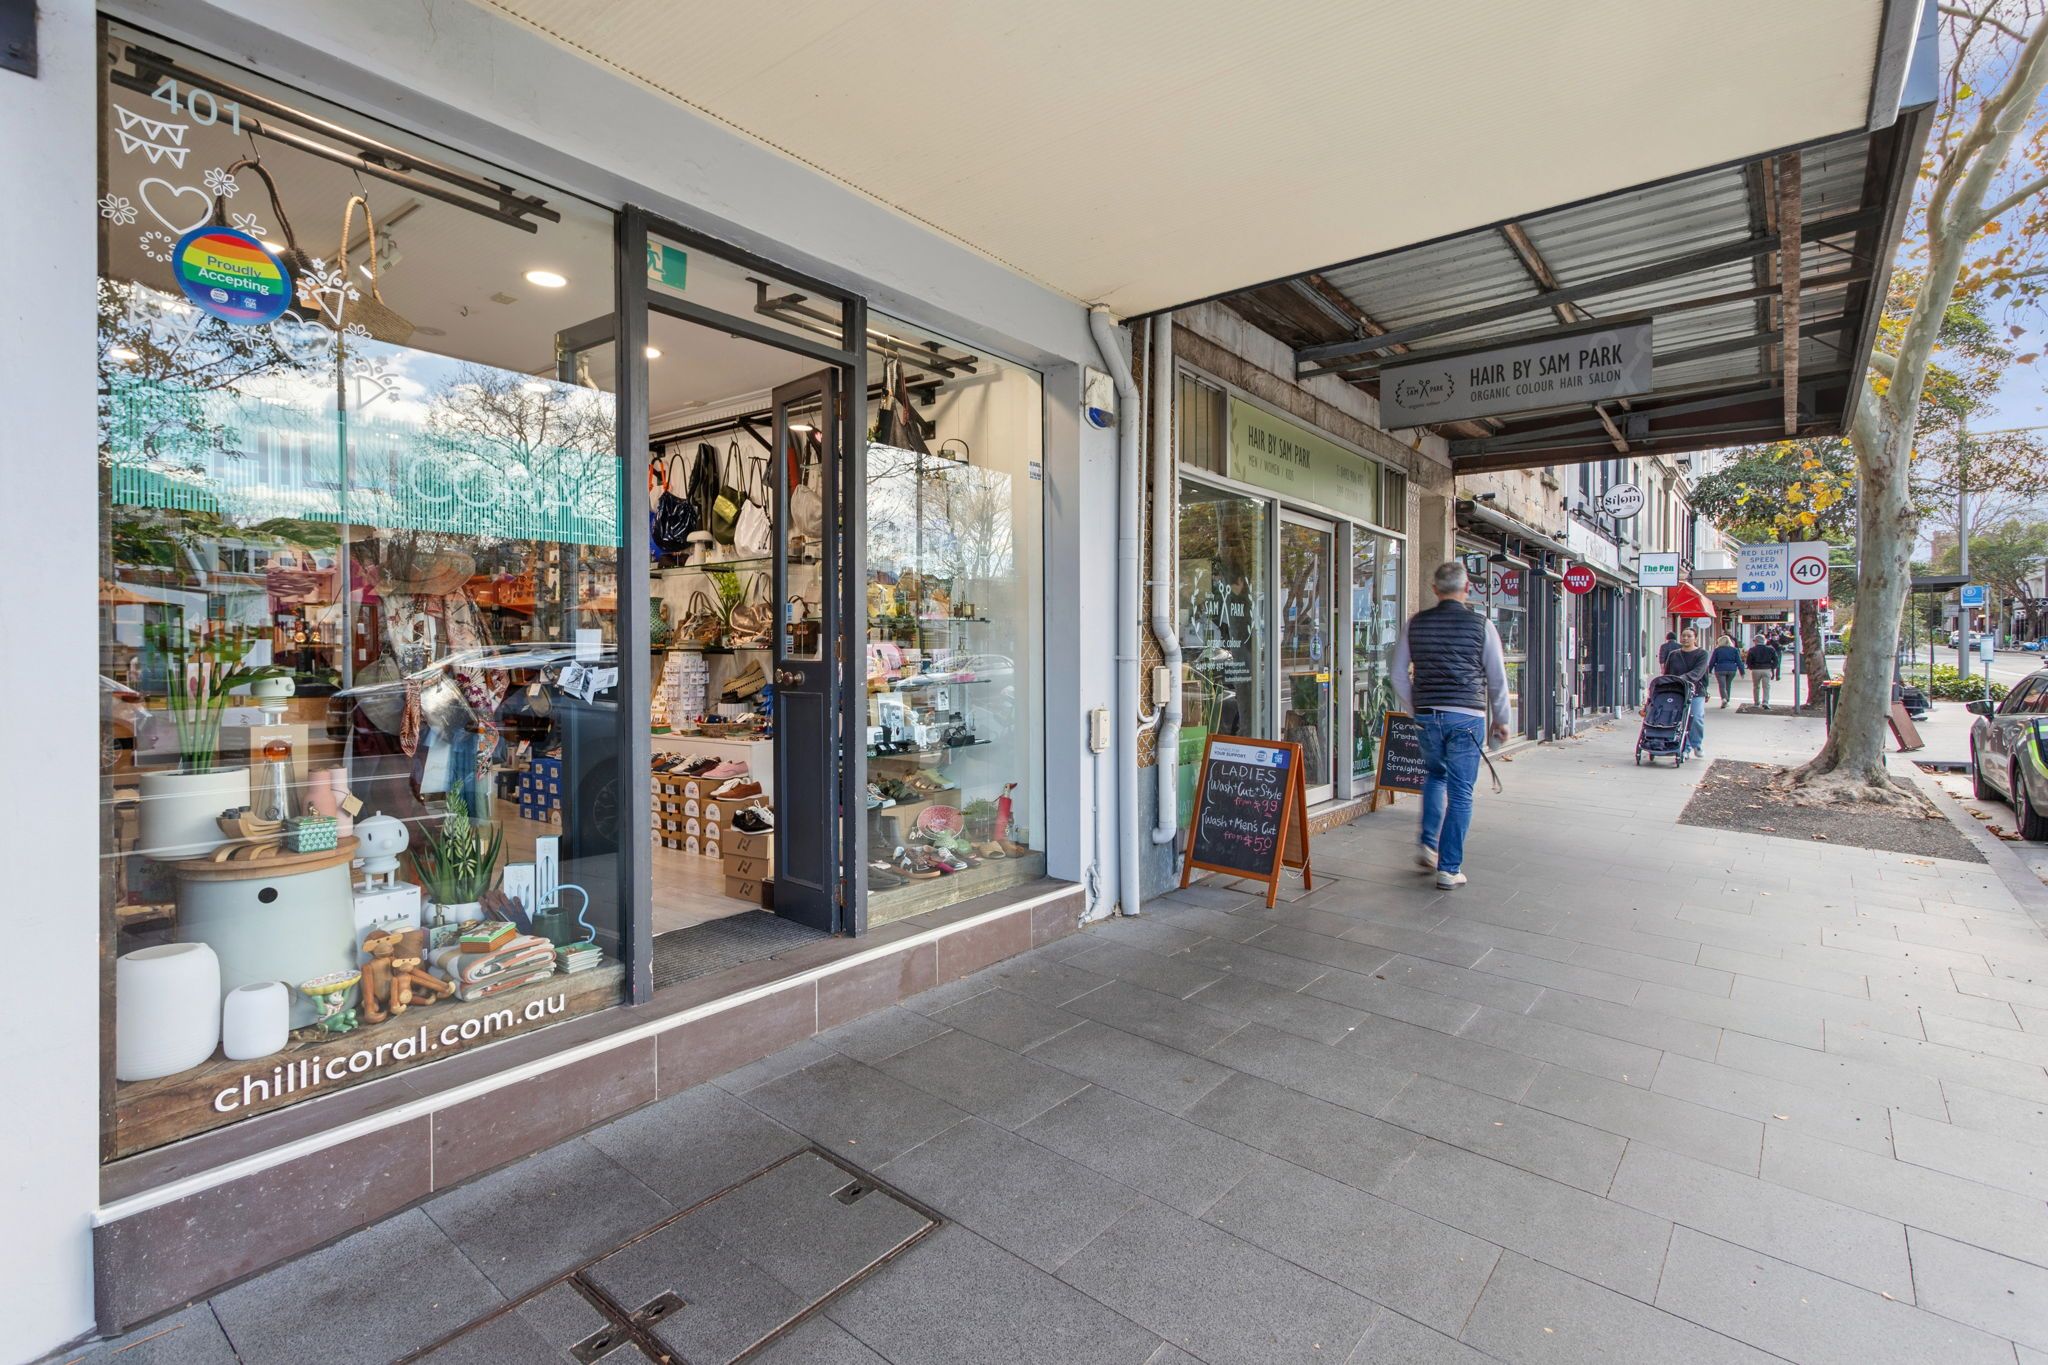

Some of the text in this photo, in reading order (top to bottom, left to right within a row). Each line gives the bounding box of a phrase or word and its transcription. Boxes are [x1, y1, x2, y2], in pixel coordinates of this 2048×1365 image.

[152, 79, 240, 136] 401
[207, 255, 262, 278] Proudly
[198, 267, 270, 296] Accepting
[1470, 344, 1623, 387] HAIR BY SAM PARK
[1406, 384, 1444, 397] SAM PARK
[1470, 369, 1622, 402] ORGANIC COLOUR HAIR SALON
[1248, 425, 1311, 470] HAIR BY SAM PARK
[1248, 455, 1258, 468] MEN
[1264, 460, 1280, 476] WOMEN
[1286, 468, 1294, 482] KIDS
[1644, 565, 1674, 573] The Pen
[1796, 564, 1821, 577] 40
[1204, 601, 1245, 617] SAM PARK
[1388, 750, 1426, 765] Permanen
[1221, 764, 1276, 783] LADIES
[1386, 763, 1429, 775] Straighten
[1234, 796, 1252, 806] from
[1224, 831, 1243, 840] from
[1261, 821, 1276, 835] Cut
[213, 993, 566, 1113] chillicoral.com.au
